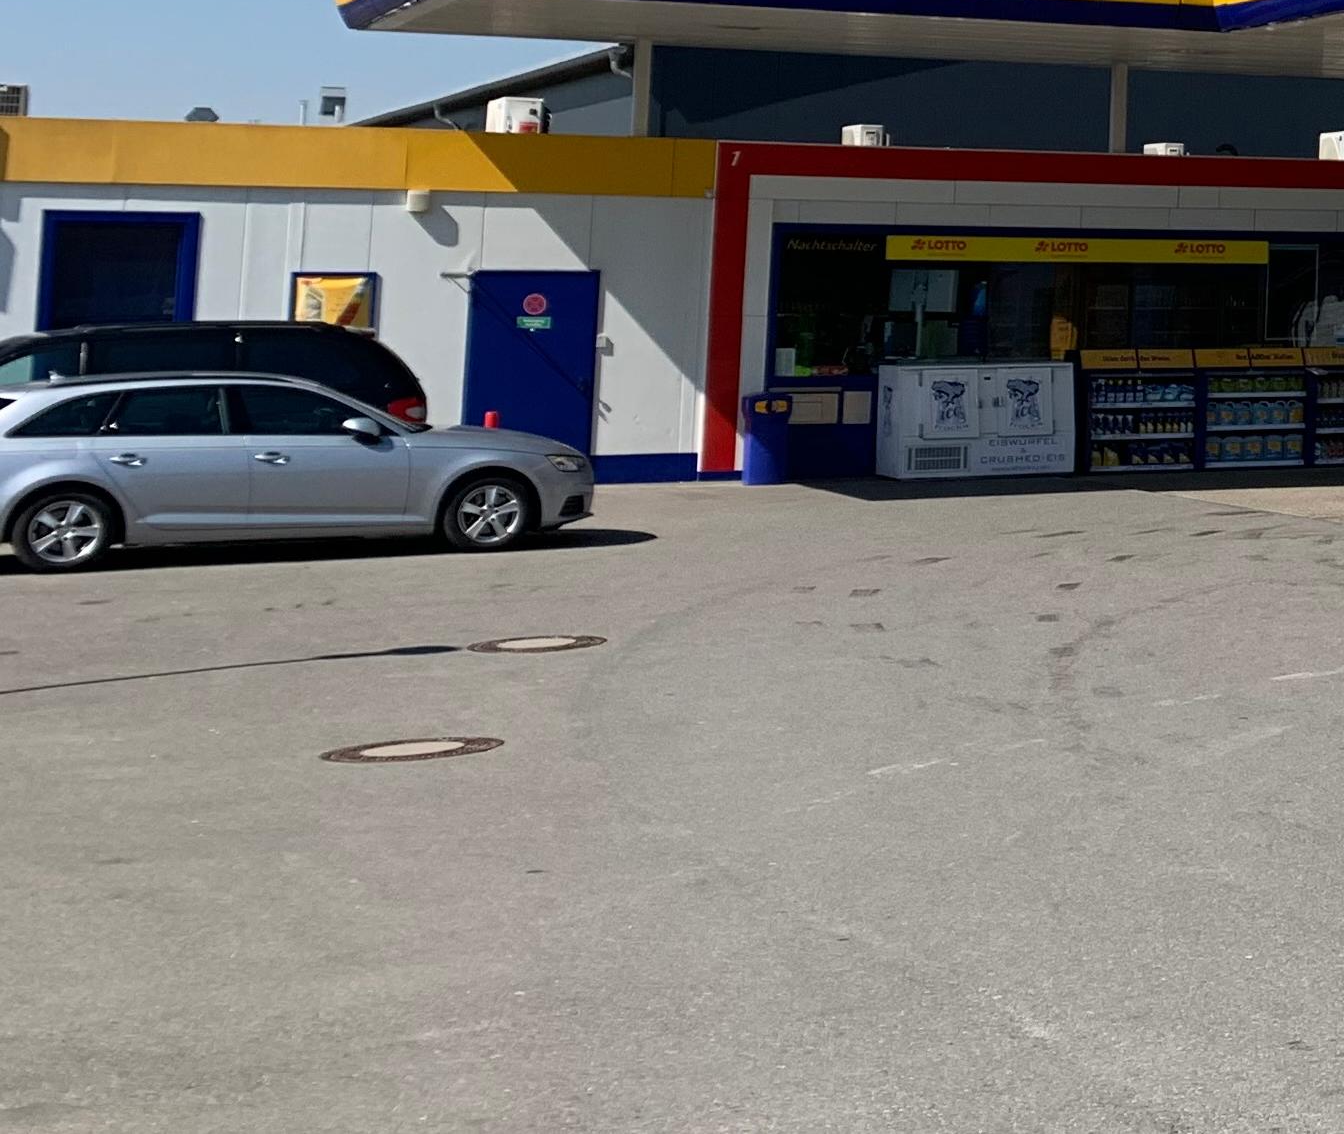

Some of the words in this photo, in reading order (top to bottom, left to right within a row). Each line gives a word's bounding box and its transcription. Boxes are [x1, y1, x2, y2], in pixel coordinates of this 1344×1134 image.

[785, 237, 879, 252] Nachtschalter
[928, 240, 967, 251] LOTTO
[1051, 241, 1089, 252] LOTTO
[1190, 243, 1226, 254] LOTTO
